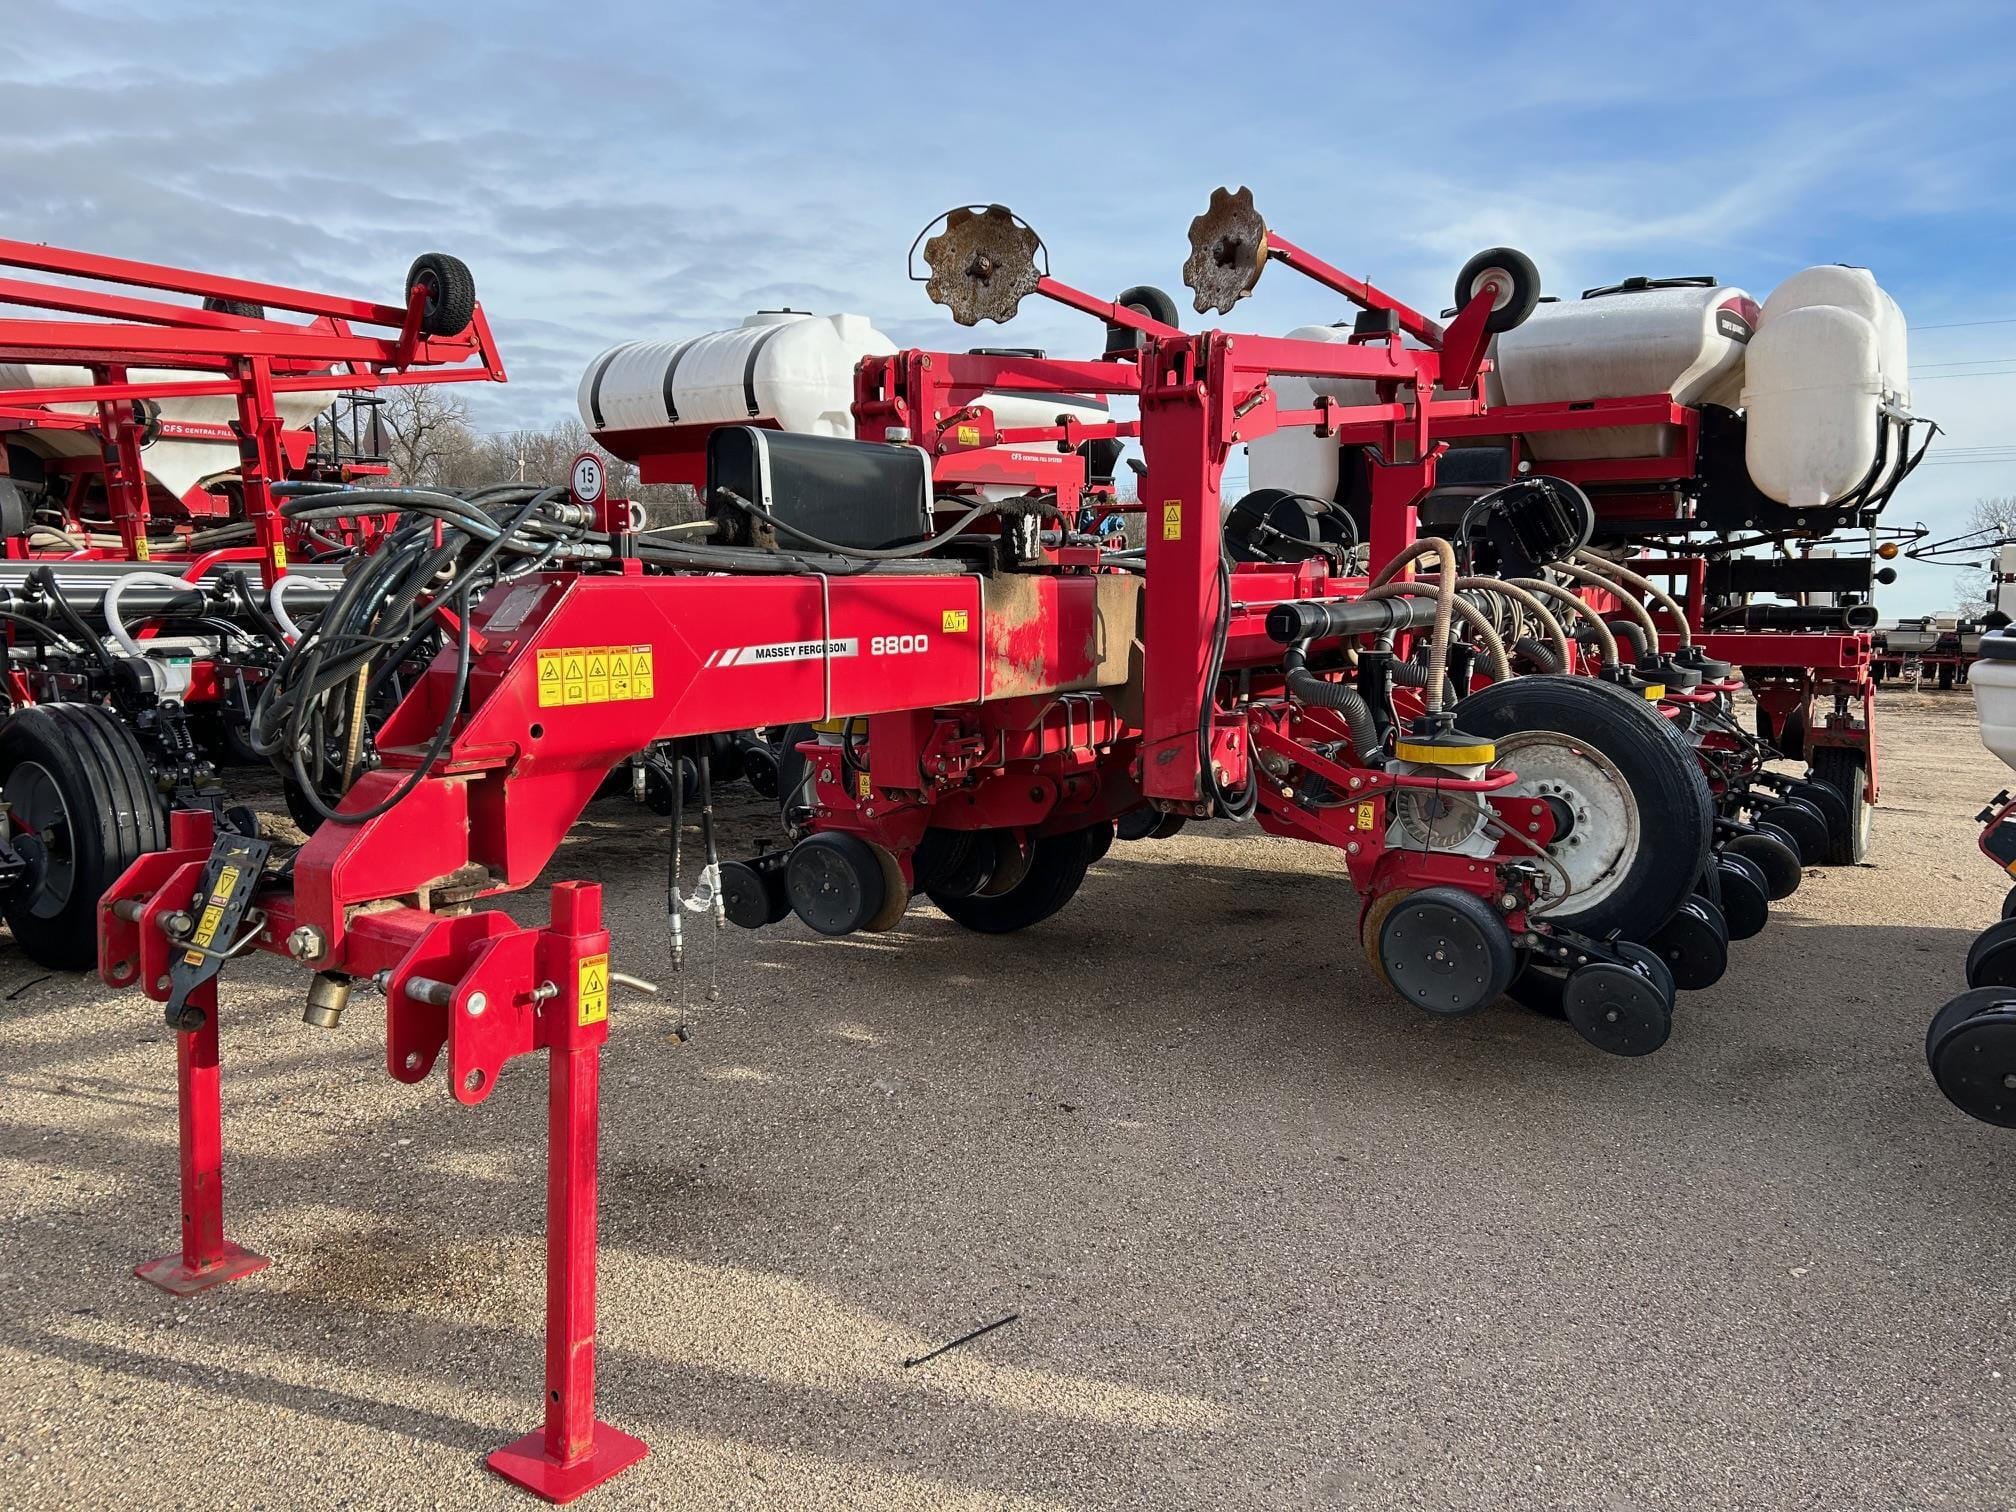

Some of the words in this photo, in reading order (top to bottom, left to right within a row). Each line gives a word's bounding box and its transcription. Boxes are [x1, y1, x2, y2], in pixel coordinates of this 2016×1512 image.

[163, 424, 183, 433] CFS
[185, 427, 216, 435] CENTRAL
[581, 466, 595, 484] 15
[755, 646, 796, 659] MASSEY
[871, 634, 928, 656] 8800
